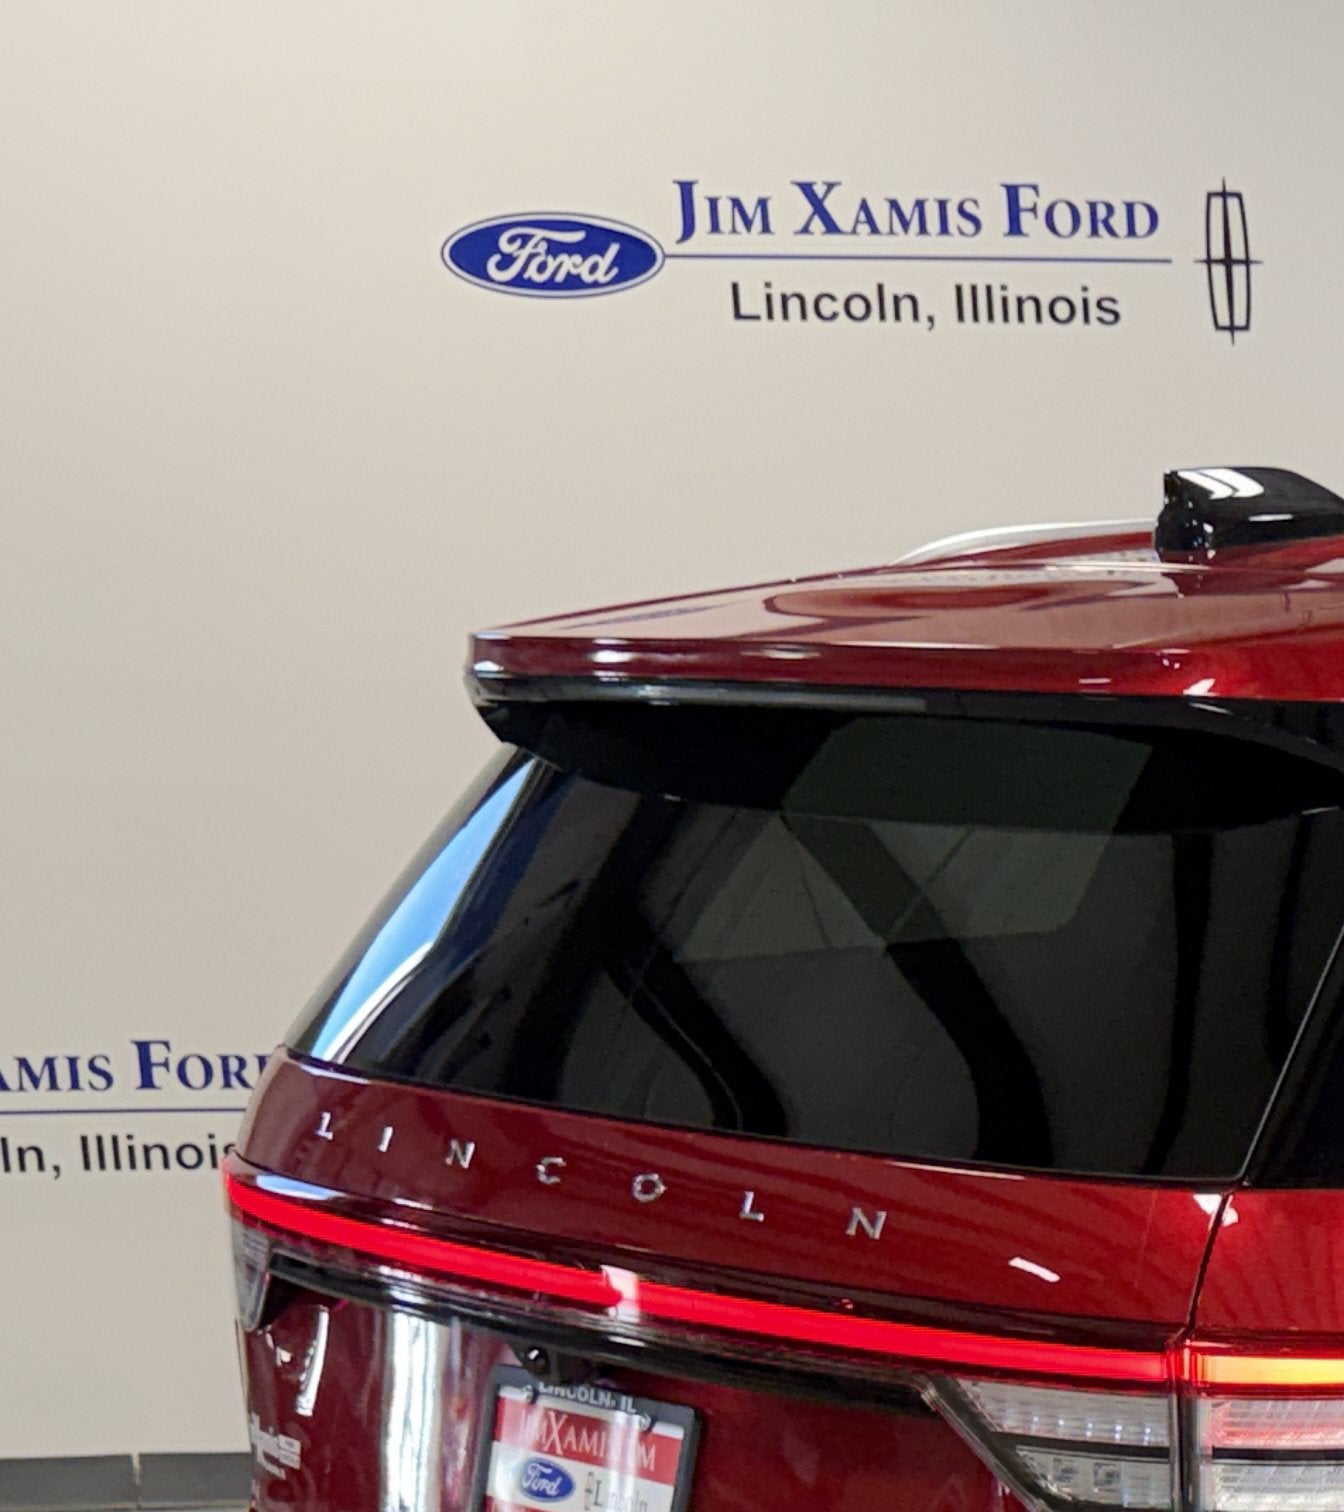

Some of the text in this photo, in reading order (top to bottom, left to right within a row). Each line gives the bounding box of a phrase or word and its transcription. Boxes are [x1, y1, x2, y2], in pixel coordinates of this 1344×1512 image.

[673, 180, 1160, 243] JIM XAMIS FORD
[487, 228, 619, 283] Ford
[732, 282, 1122, 331] Lincoln, Illinois
[316, 1111, 887, 1240] LINCOLN
[522, 1463, 562, 1496] Ford
